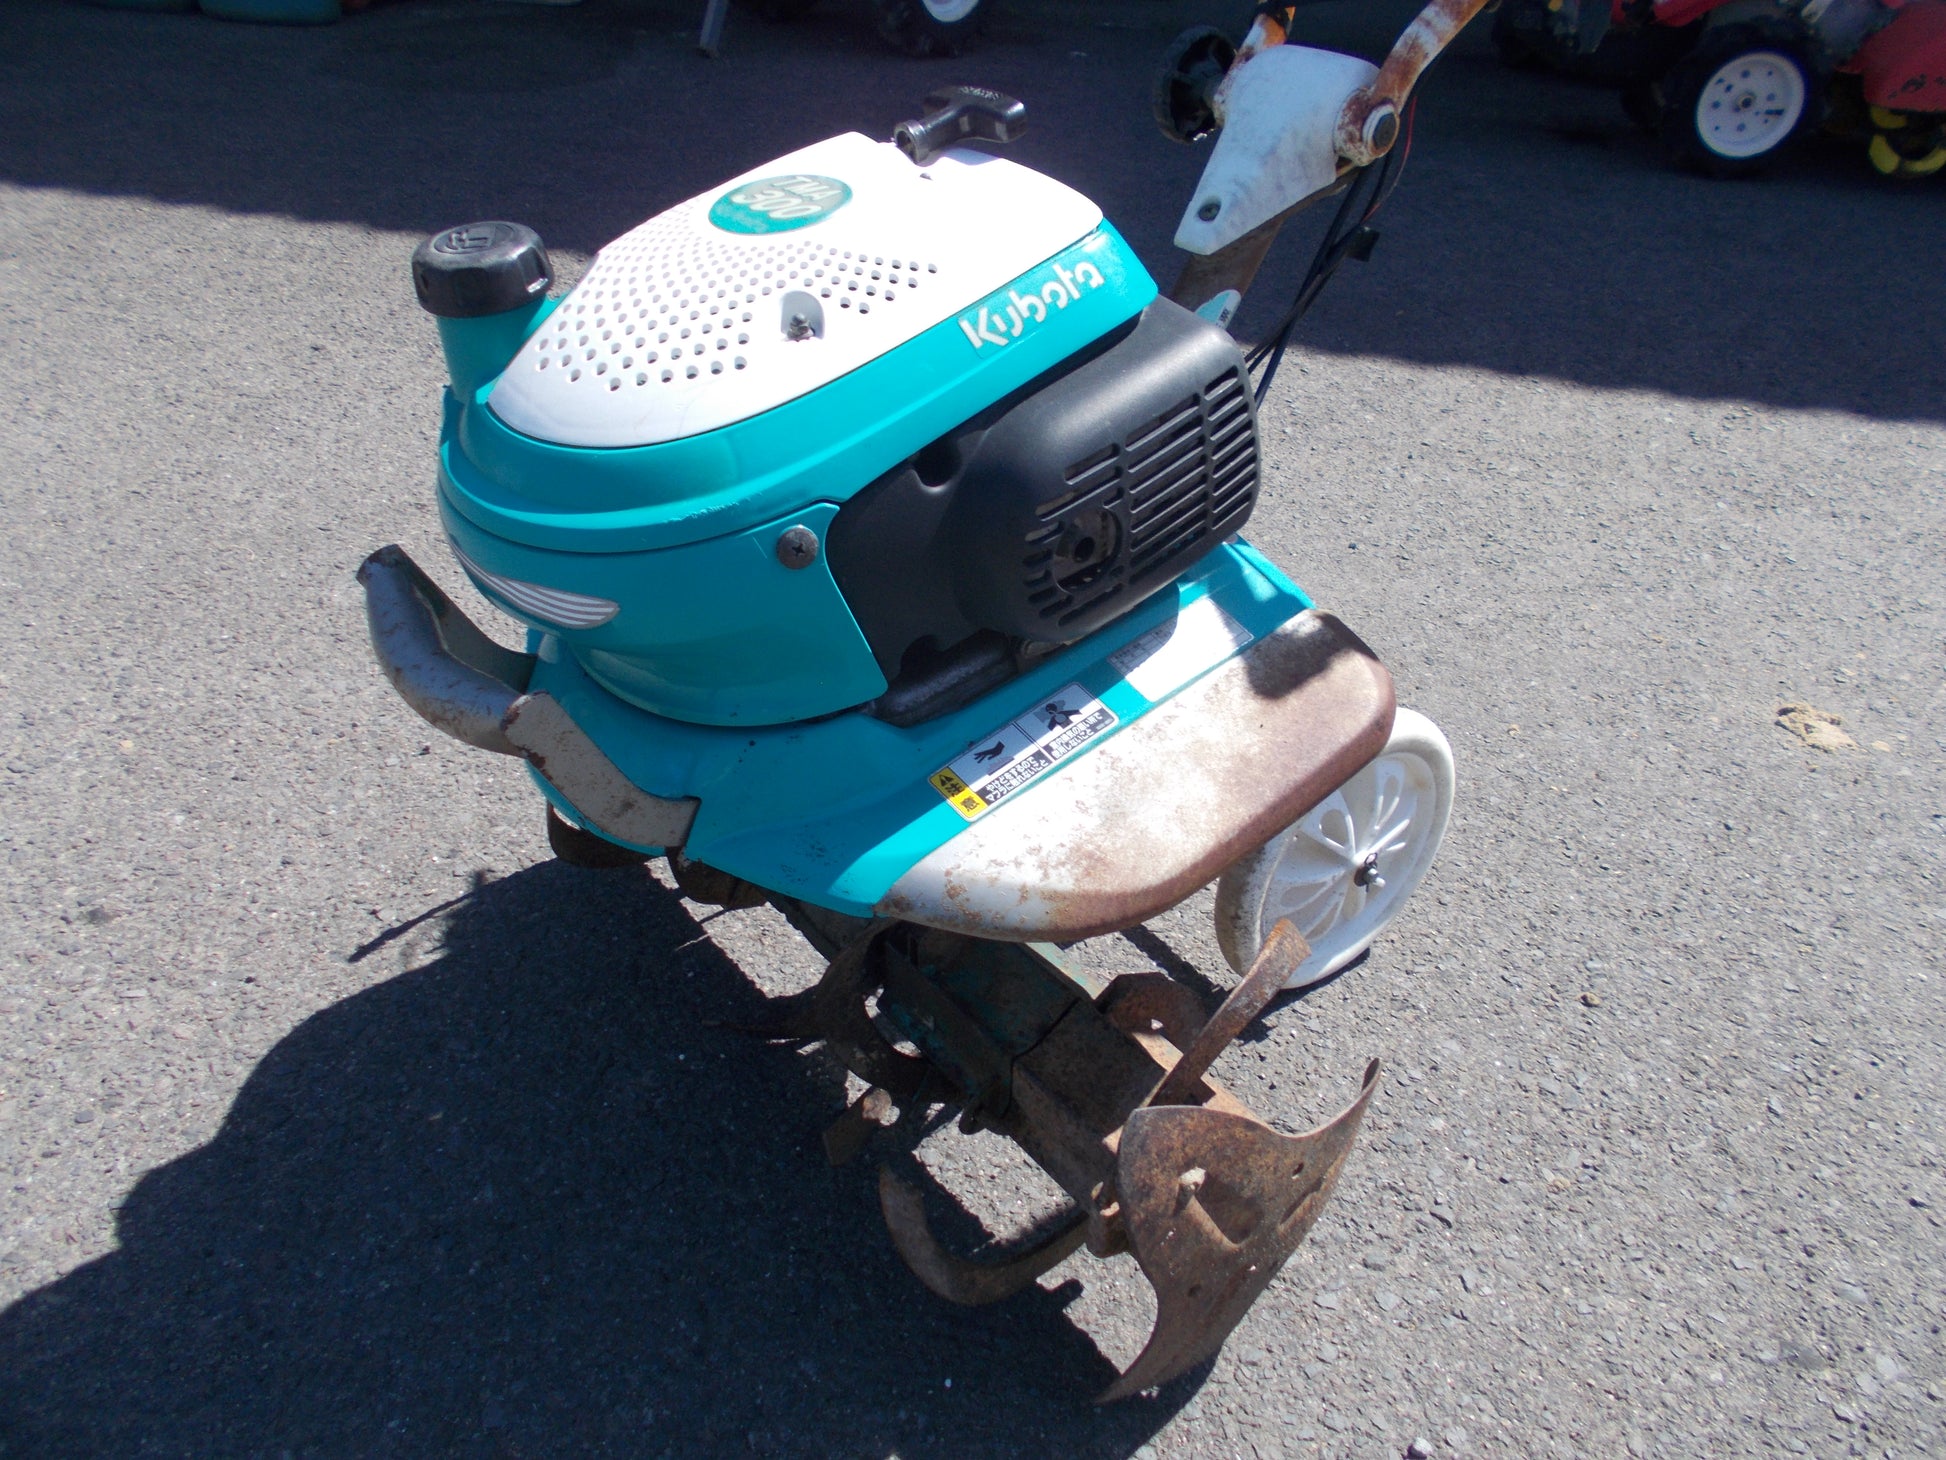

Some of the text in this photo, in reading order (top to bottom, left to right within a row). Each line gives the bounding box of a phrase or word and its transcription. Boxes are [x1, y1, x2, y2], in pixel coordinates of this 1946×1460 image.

[772, 176, 842, 201] TMA
[731, 190, 822, 219] 300
[959, 262, 1105, 349] Kubota
[986, 756, 1037, 792] やけどをするので
[945, 782, 980, 812] 注意
